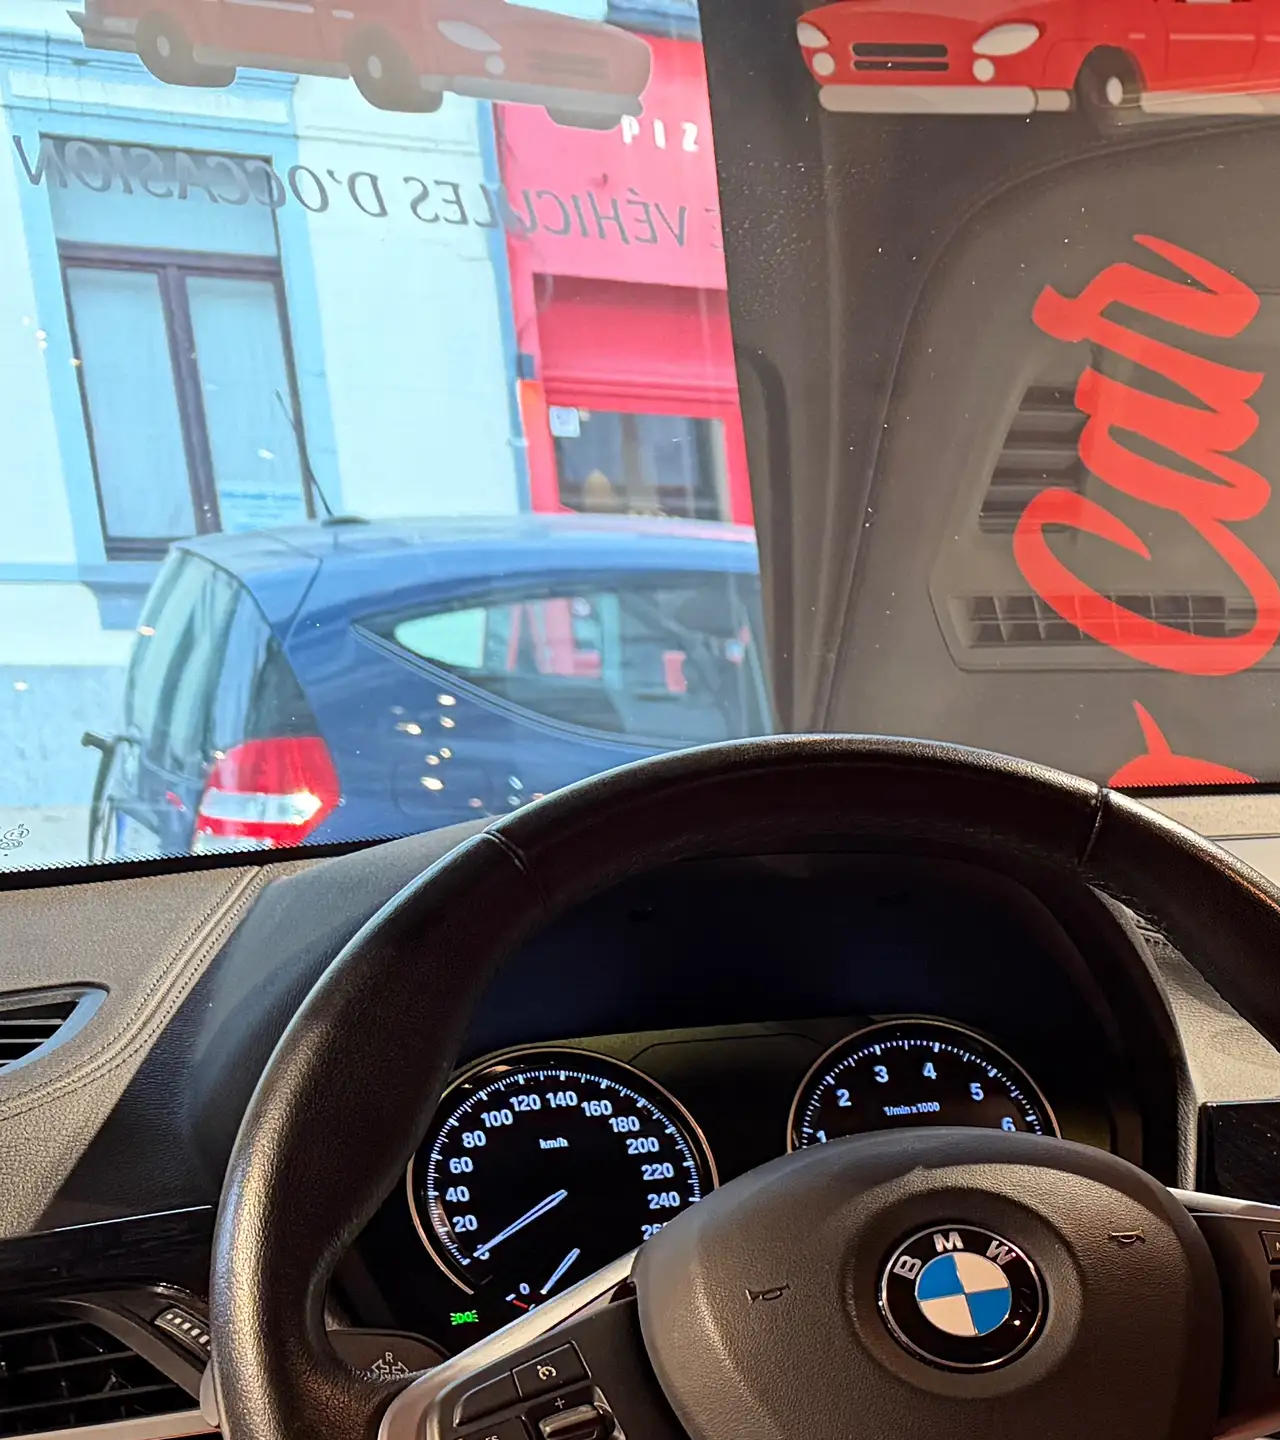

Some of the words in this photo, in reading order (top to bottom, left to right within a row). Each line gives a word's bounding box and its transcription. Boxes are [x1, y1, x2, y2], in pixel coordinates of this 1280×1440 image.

[873, 1065, 889, 1083] 3
[922, 1062, 937, 1080] 4
[545, 1091, 578, 1108] 140
[836, 1088, 852, 1107] 2
[969, 1082, 985, 1101] 5
[509, 1093, 541, 1112] 120
[581, 1100, 613, 1117] 160
[481, 1109, 514, 1128] 100
[608, 1116, 640, 1133] 180
[1001, 1116, 1016, 1132] 6
[461, 1130, 487, 1148] 80
[539, 1136, 569, 1149] km/h
[815, 1129, 827, 1144] 1
[626, 1137, 660, 1155] 200
[449, 1156, 474, 1174] 60
[641, 1162, 675, 1181] 220
[445, 1185, 470, 1203] 40
[647, 1191, 681, 1210] 240
[452, 1214, 478, 1233] 20
[641, 1222, 668, 1241] 26
[893, 1231, 1017, 1280] BMW
[385, 1352, 394, 1363] R
